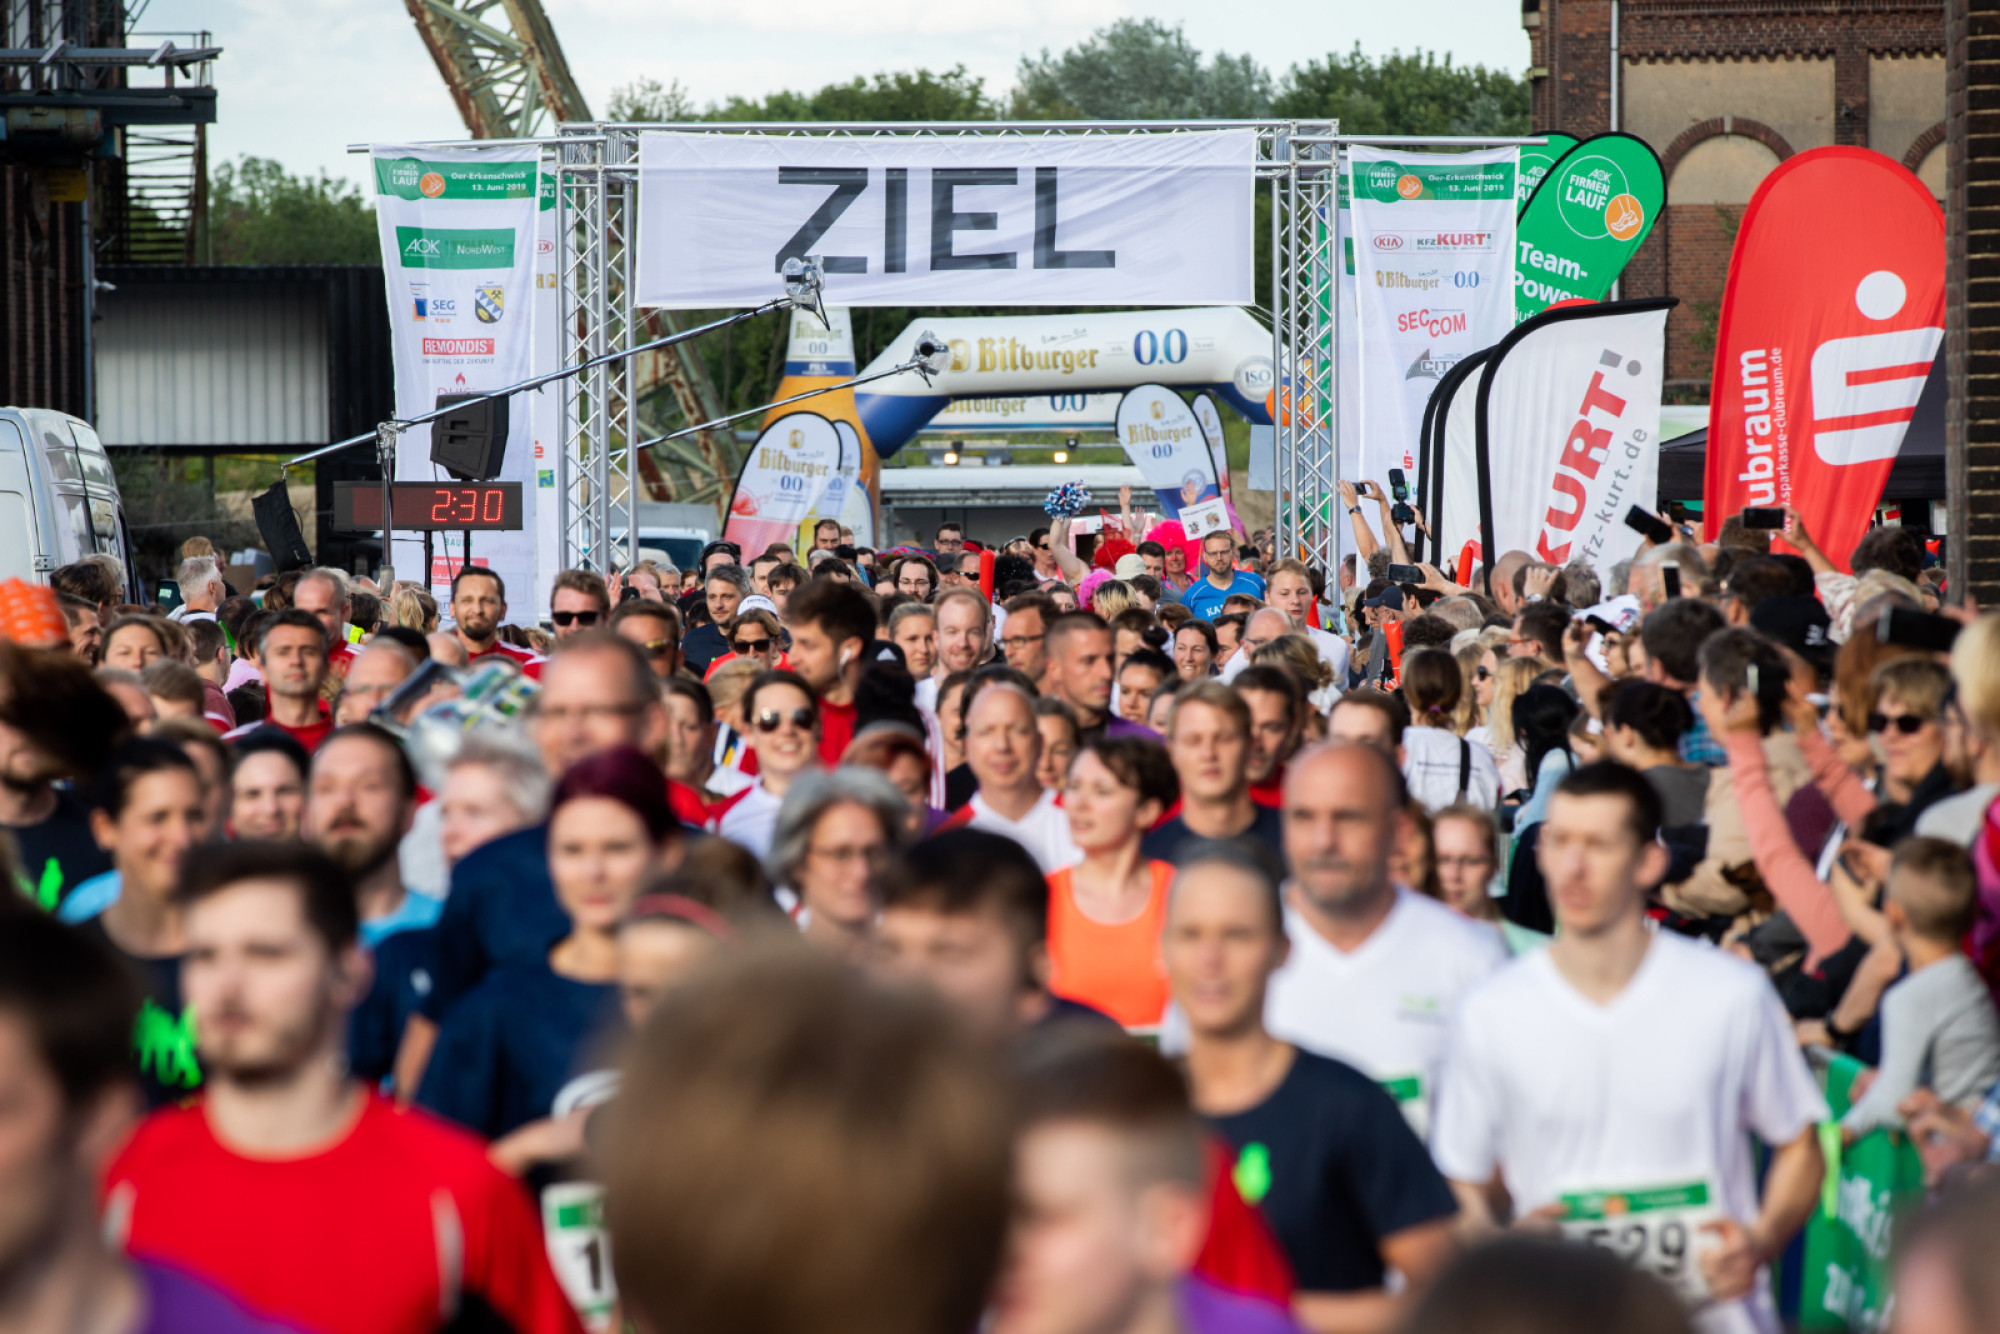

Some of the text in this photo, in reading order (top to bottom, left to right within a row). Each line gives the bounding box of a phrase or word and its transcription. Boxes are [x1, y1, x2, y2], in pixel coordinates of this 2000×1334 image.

[392, 169, 420, 177] FIRMEN
[392, 176, 418, 186] LAUF
[451, 172, 527, 180] Oer-Erkenschwick
[1428, 173, 1504, 182] Oer-Erkenschwick
[1588, 168, 1613, 184] AOK
[506, 183, 527, 191] 2019
[1370, 178, 1396, 188] LAUF
[1463, 184, 1481, 192] Juni
[1484, 184, 1504, 192] 2019
[1570, 174, 1610, 196] FIRMEN
[1565, 186, 1608, 211] LAUF
[775, 166, 1116, 274] ZIEL
[404, 238, 440, 254] AOK
[1379, 237, 1398, 248] KIA
[1519, 240, 1588, 281] Team-
[1386, 270, 1480, 290] Bitburger 0.0
[1515, 270, 1583, 304] Powe
[432, 300, 456, 310] SEG
[424, 340, 488, 353] REMONDIS
[976, 328, 1188, 374] Bitburger 0.0
[1245, 370, 1271, 384] ISO
[1128, 424, 1192, 445] Bitburger
[1739, 349, 1776, 506] ubraum
[758, 447, 828, 478] Bitburger
[1536, 349, 1642, 566] KURT!
[1582, 428, 1648, 558] fz-kurt.de
[432, 490, 504, 522] 2:30
